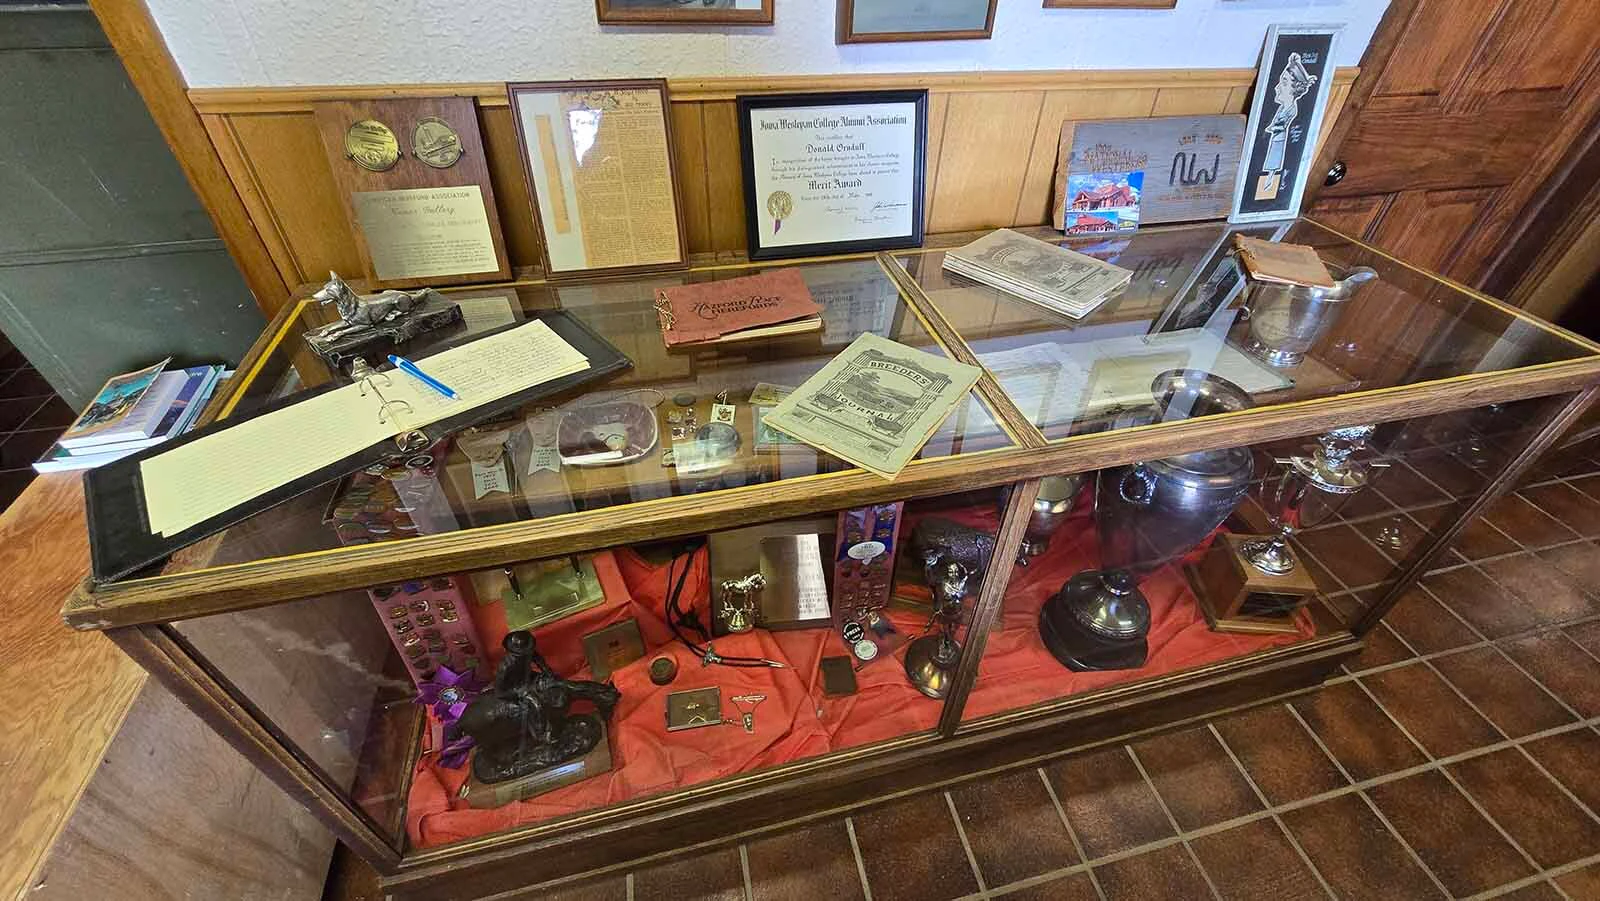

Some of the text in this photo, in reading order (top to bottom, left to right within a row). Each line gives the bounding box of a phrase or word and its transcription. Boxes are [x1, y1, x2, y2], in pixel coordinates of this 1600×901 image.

[813, 116, 840, 129] College
[840, 115, 865, 126] Alumni
[866, 114, 907, 126] Association
[805, 144, 835, 153] Donald
[807, 178, 862, 190] Merit Award
[834, 393, 894, 420] JOURNAL
